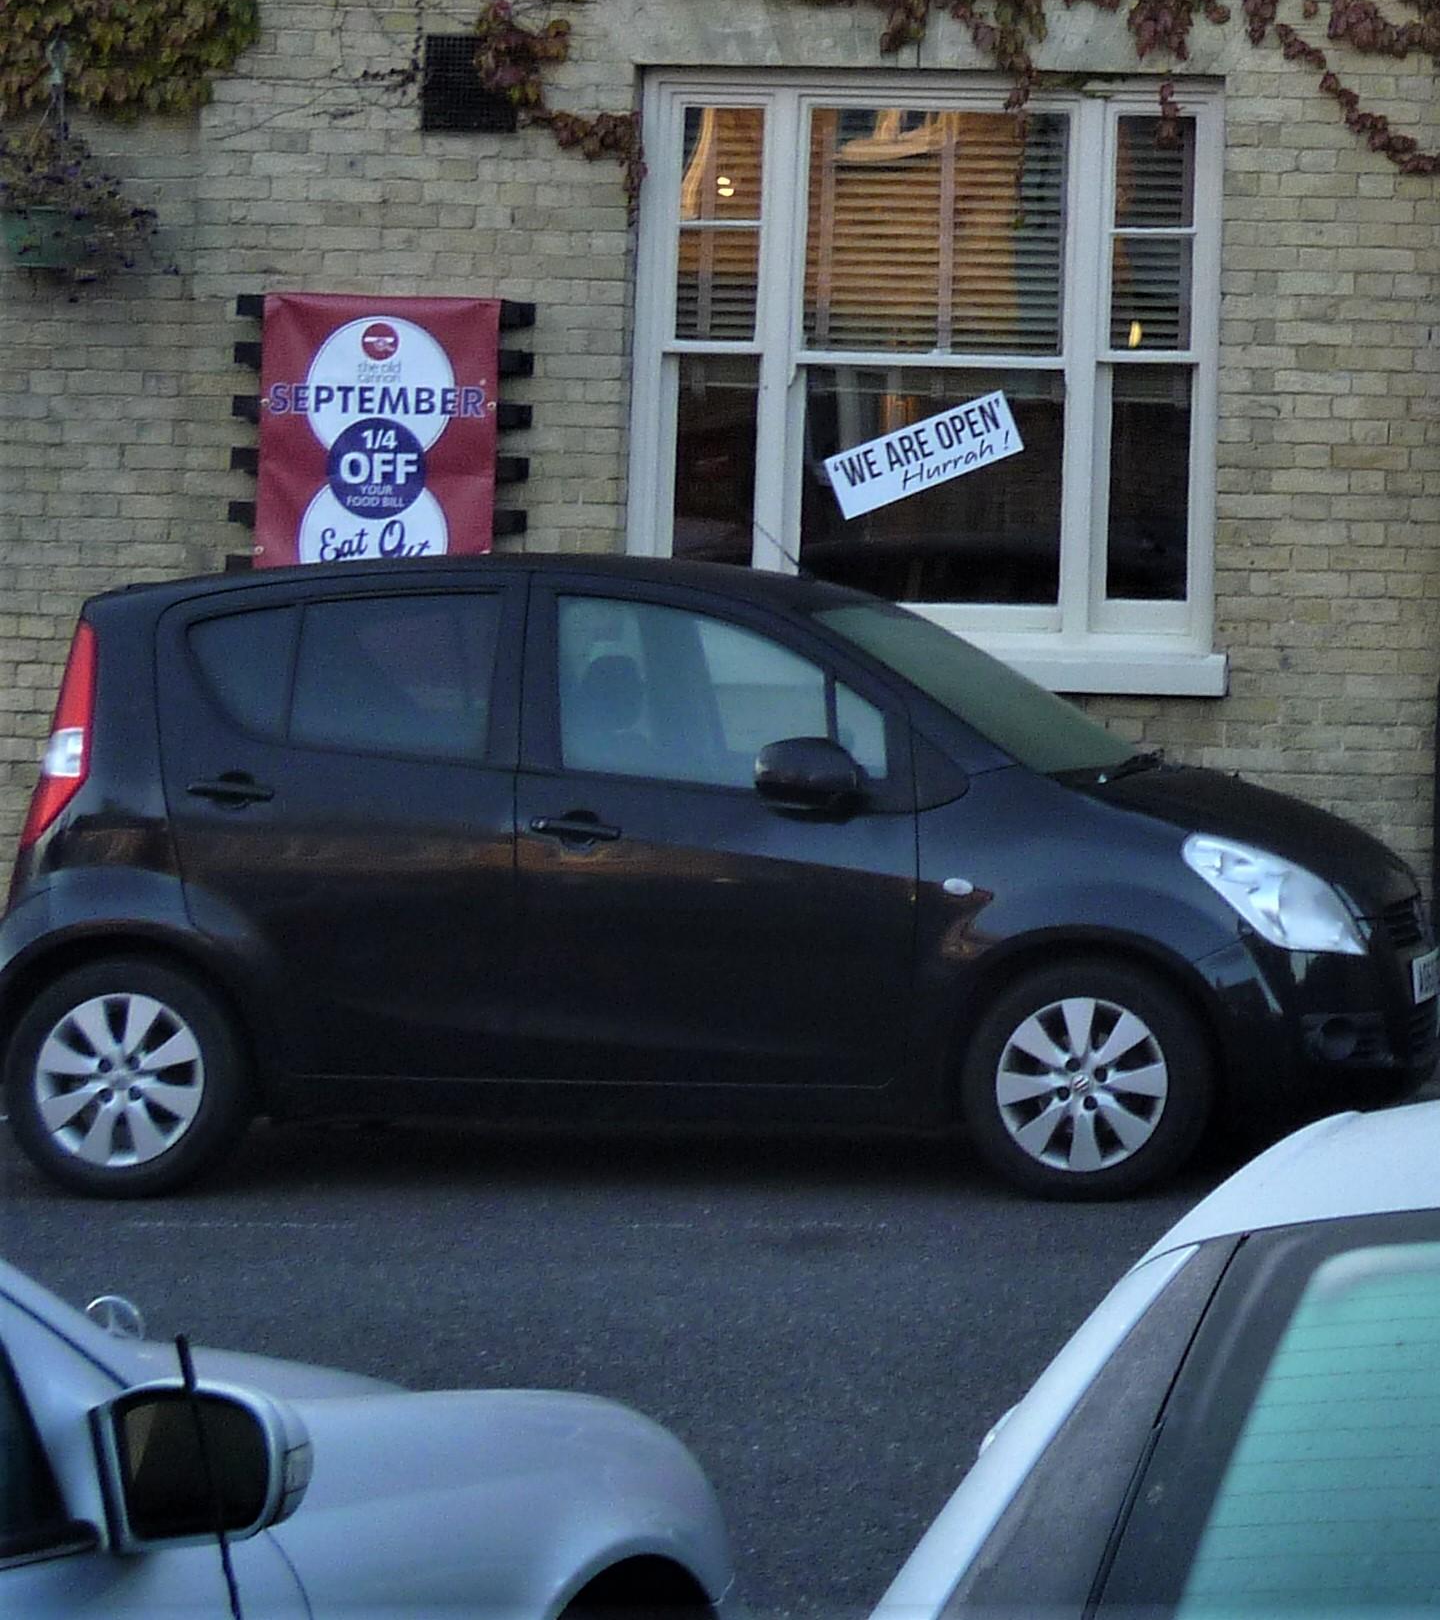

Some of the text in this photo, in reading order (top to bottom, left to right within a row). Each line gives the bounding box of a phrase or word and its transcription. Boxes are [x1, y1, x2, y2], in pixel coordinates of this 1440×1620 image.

[269, 383, 486, 419] SEPTEMBER
[361, 429, 398, 451] 1/4
[886, 428, 934, 473] ARE
[339, 452, 419, 484] OFF
[346, 496, 405, 507] FOOD BILL
[360, 484, 393, 496] YOUR
[320, 527, 369, 562] Eat
